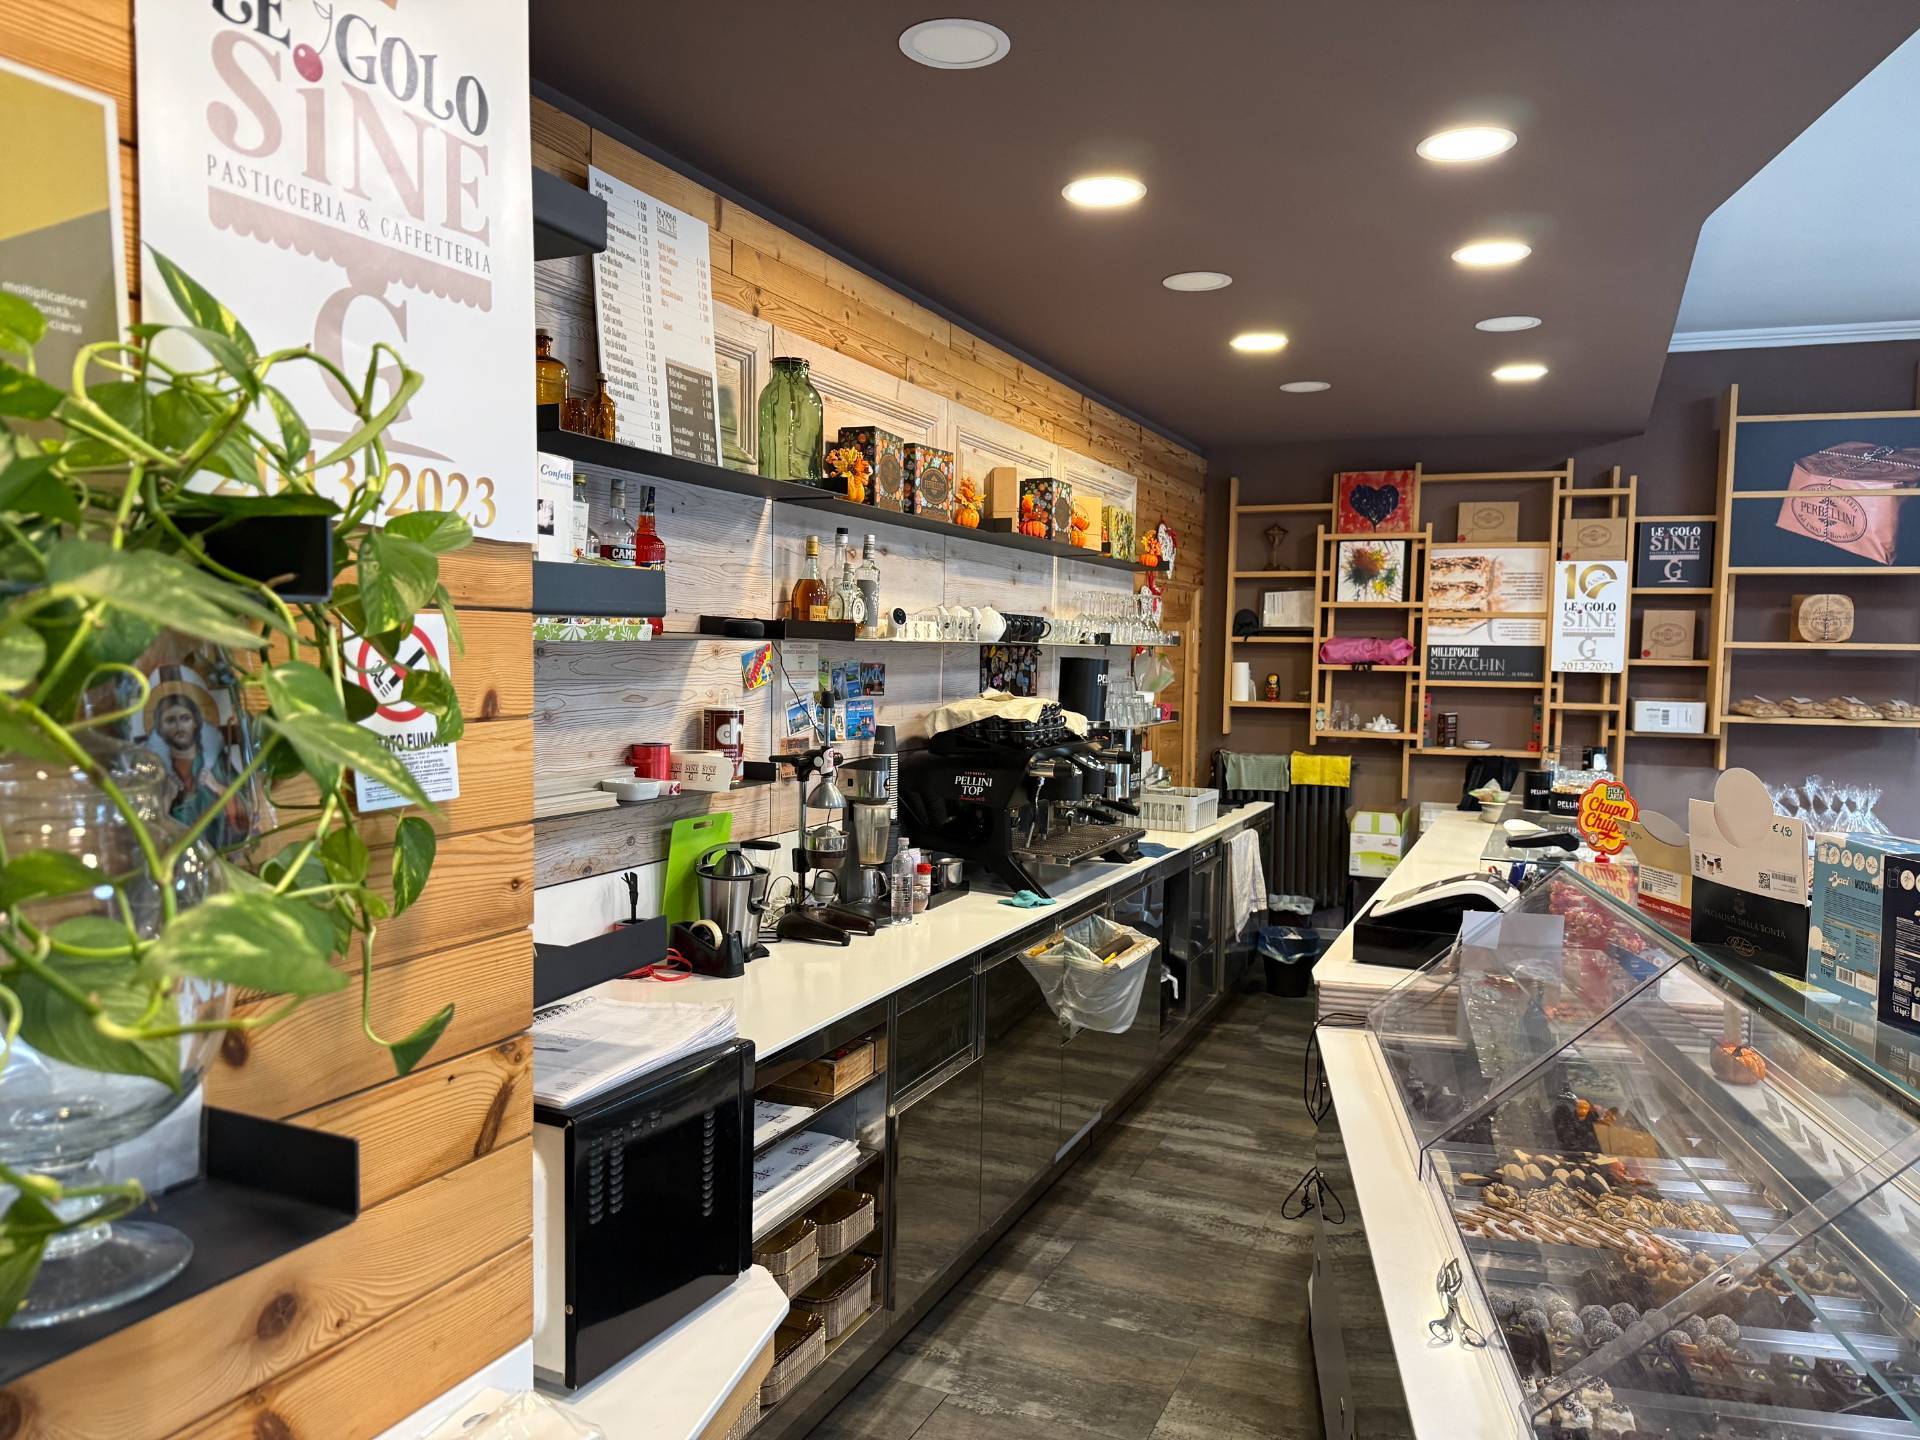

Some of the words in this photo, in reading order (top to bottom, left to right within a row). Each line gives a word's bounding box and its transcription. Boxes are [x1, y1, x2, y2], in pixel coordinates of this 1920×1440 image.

[335, 14, 489, 136] GOLO
[206, 154, 347, 224] PASTICCERIA
[357, 208, 370, 232] &
[380, 216, 492, 274] CAFFETTERIA
[314, 287, 413, 424] G
[540, 463, 572, 481] Confetti
[1800, 500, 1856, 528] PERBLLINI
[1651, 527, 1664, 537] LE
[1670, 526, 1700, 536] GOLO
[1564, 602, 1578, 612] LE
[1584, 602, 1617, 612] GOLO
[1430, 647, 1480, 658] MILLEFOGLIE
[1578, 640, 1597, 659] G
[1430, 658, 1505, 672] STRACHIN
[1561, 662, 1614, 672] 2013-2023
[954, 775, 993, 787] PELLINI
[961, 785, 984, 796] TOP
[1557, 800, 1580, 809] PELLIN
[1589, 797, 1629, 818] Chupa
[1584, 812, 1620, 834] Chup
[1772, 823, 1779, 833] €
[1829, 871, 1850, 888] Baci
